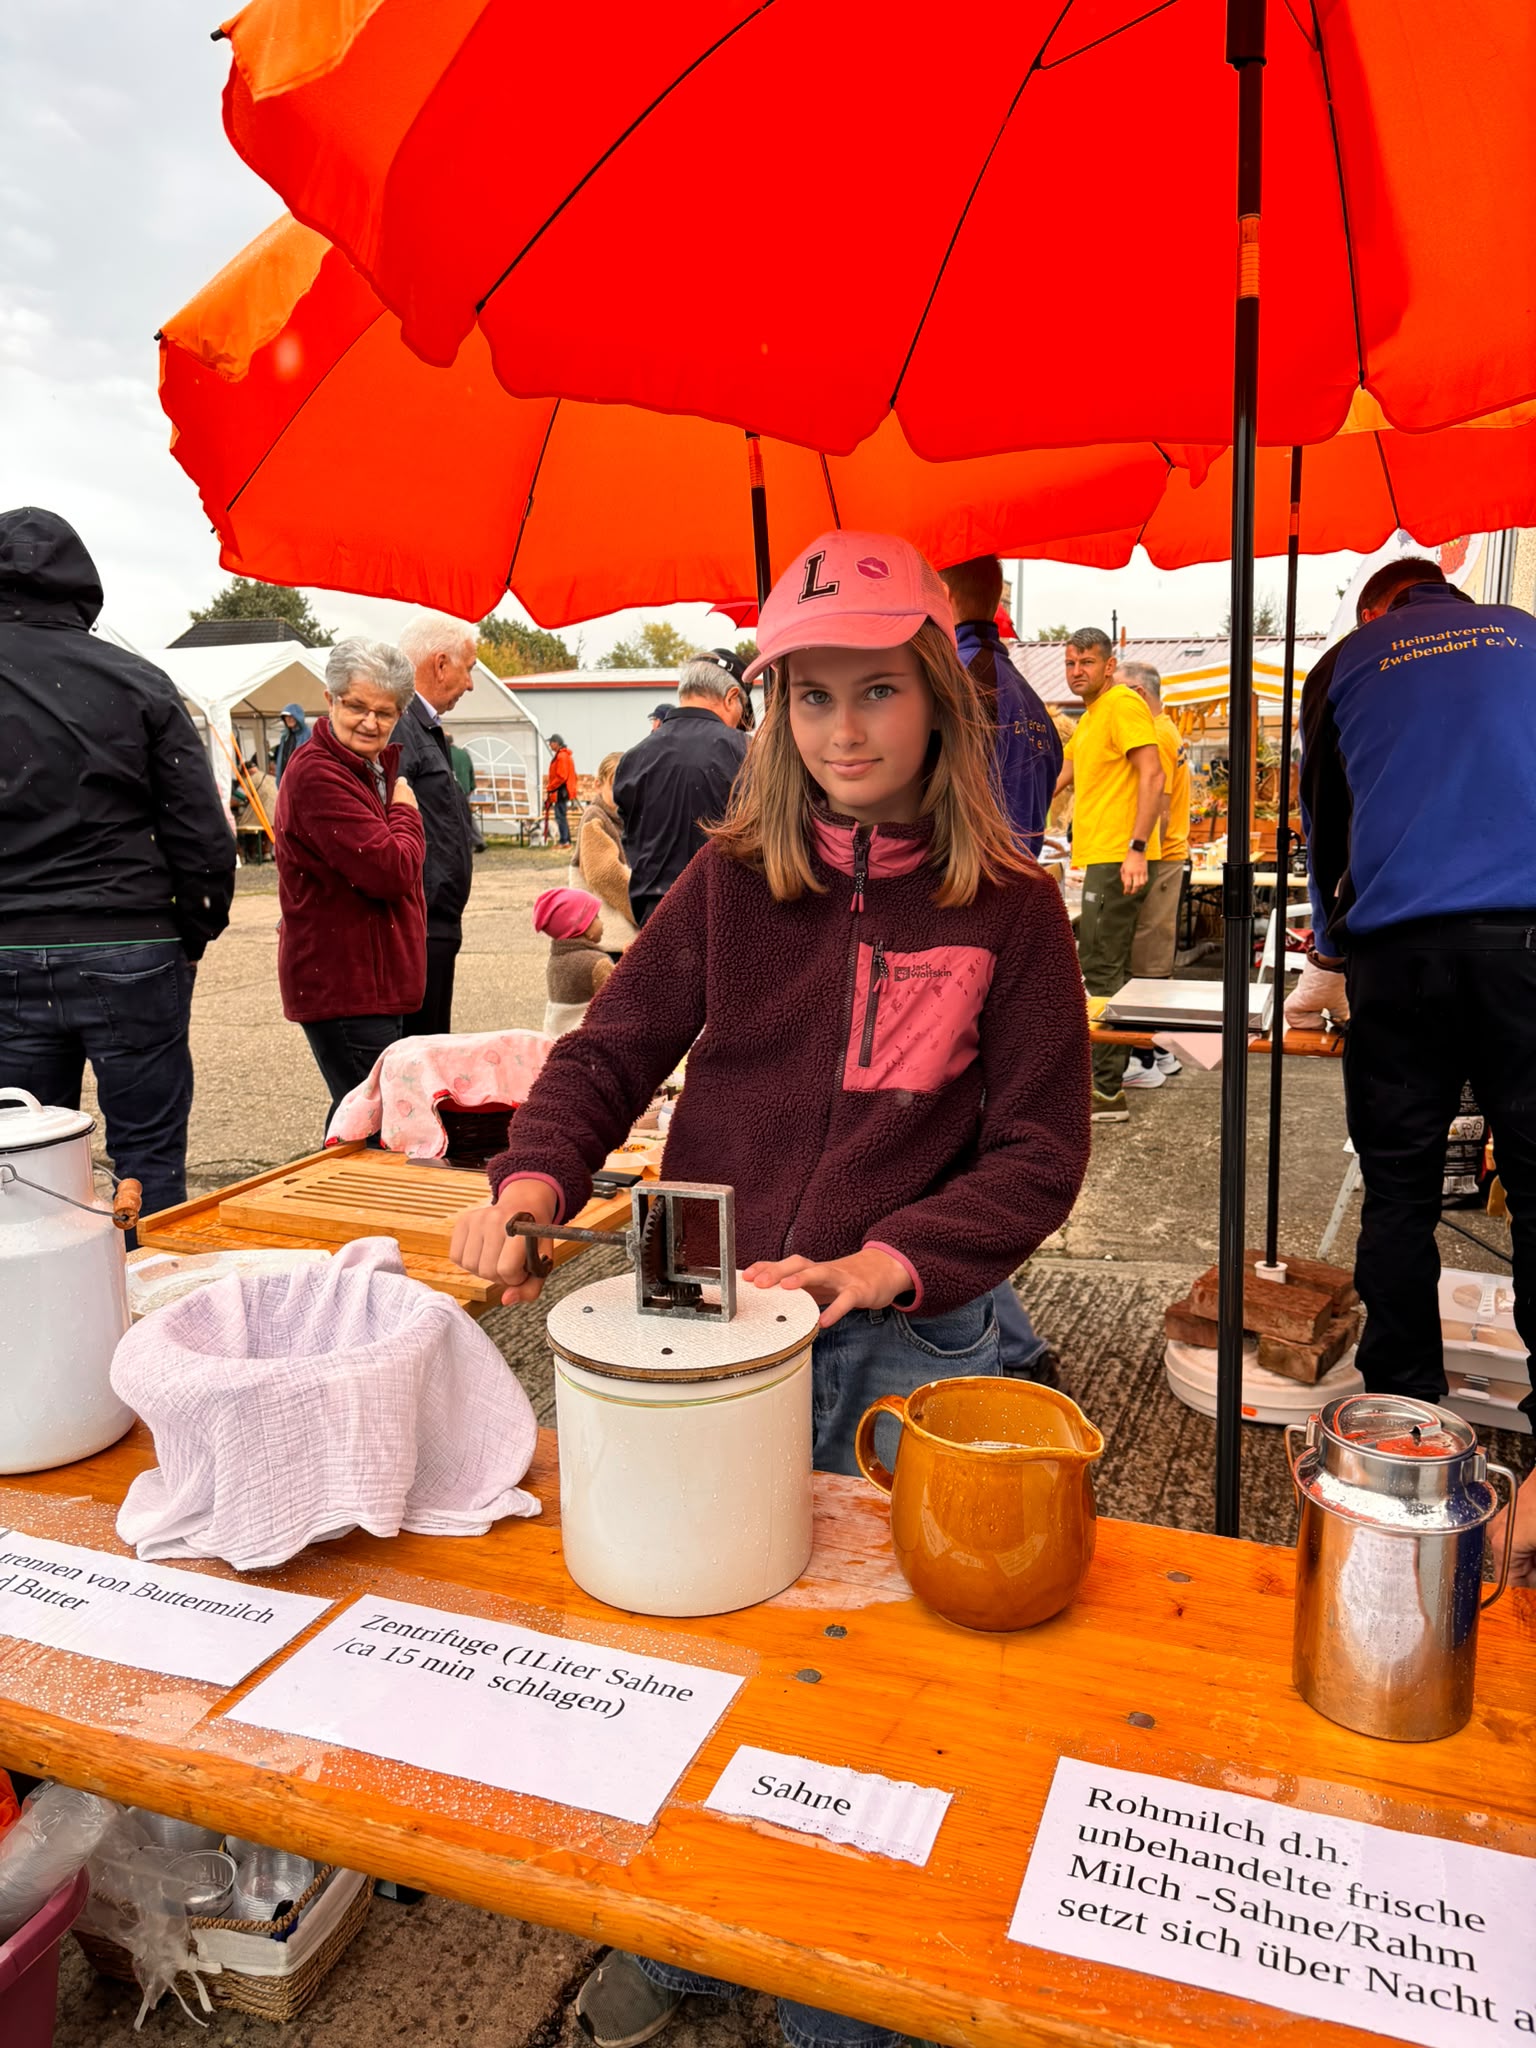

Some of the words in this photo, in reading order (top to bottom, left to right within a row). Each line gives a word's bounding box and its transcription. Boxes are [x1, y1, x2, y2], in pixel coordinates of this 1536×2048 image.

[798, 550, 840, 604] L
[1379, 637, 1479, 672] Zwebendorf
[1391, 624, 1505, 651] Heimatverein
[0, 1552, 83, 1580] trennen
[86, 1573, 130, 1593] von
[129, 1581, 275, 1624] Buttermilch
[9, 1577, 90, 1612] Butter
[333, 1637, 377, 1658] /ca
[379, 1647, 420, 1665] 15
[418, 1656, 476, 1682] min
[487, 1674, 626, 1719] schlagen)
[361, 1614, 499, 1657] Zentrifuge
[605, 1668, 694, 1703] Sahne
[752, 1774, 852, 1816] Sahne
[1084, 1786, 1268, 1847] Rohmilch
[1279, 1832, 1350, 1867] d.h.
[1066, 1853, 1182, 1902] Milch
[1196, 1887, 1479, 1973] -Sahne/Rahm
[1077, 1823, 1333, 1900] unbehandelte
[1345, 1882, 1488, 1934] frische
[1057, 1897, 1150, 1936] setzt
[1160, 1919, 1242, 1958] sich
[1256, 1941, 1351, 1985] über
[1364, 1965, 1499, 2024] Nacht
